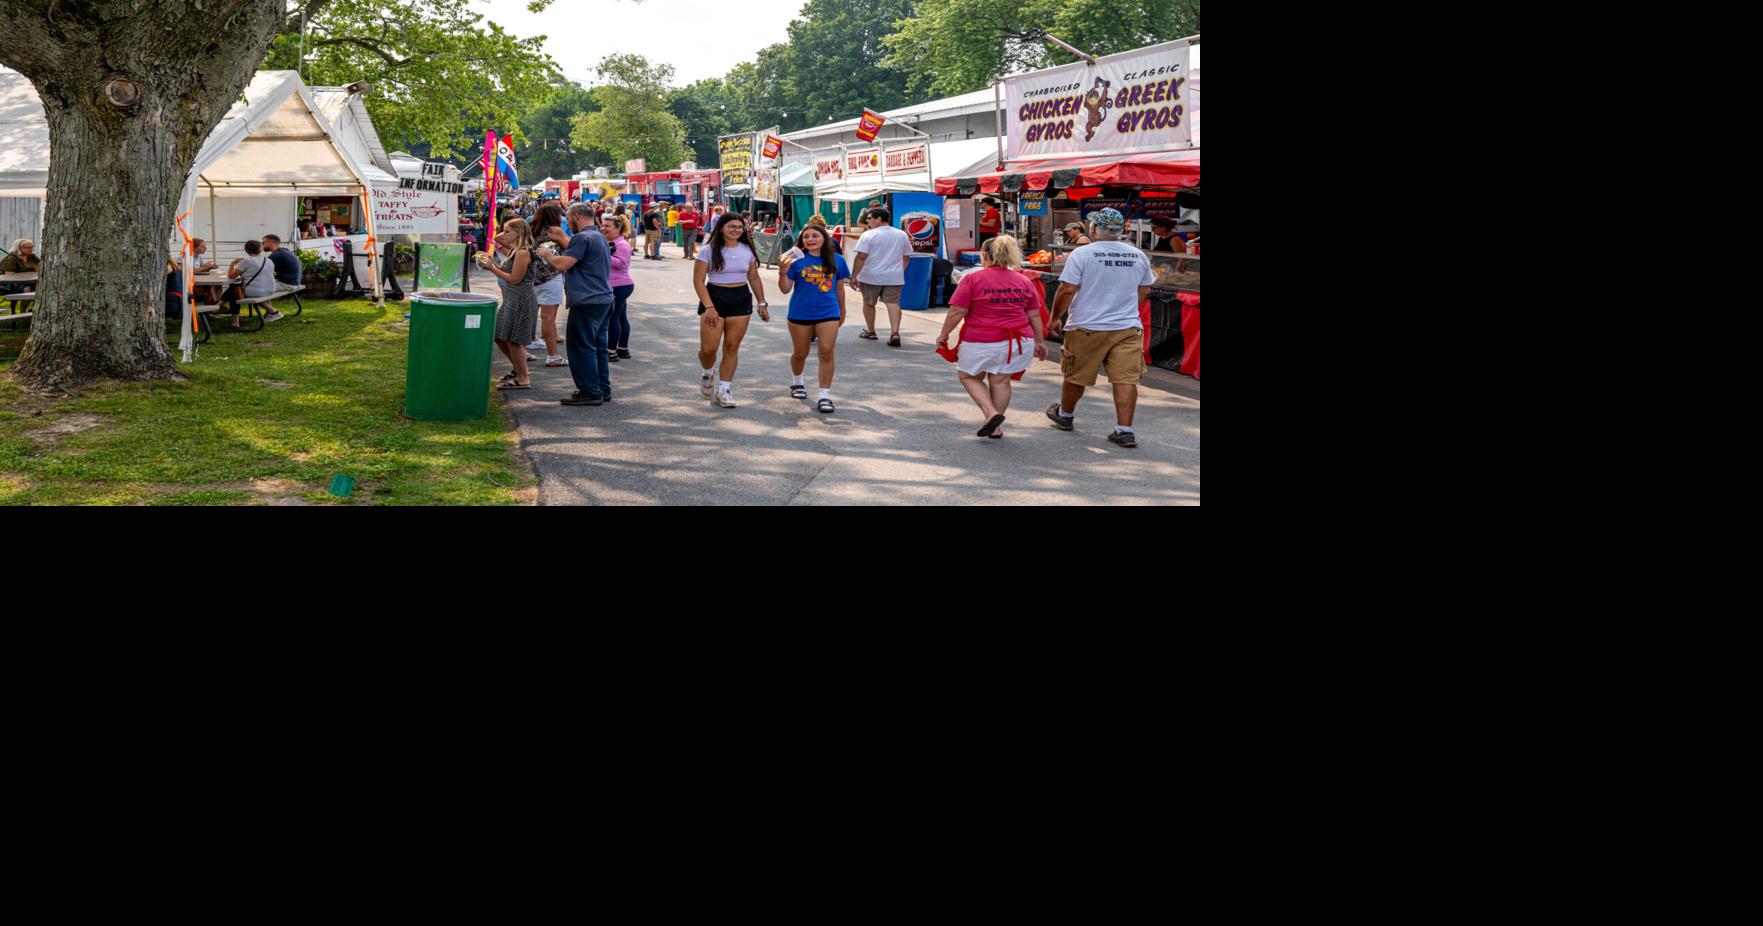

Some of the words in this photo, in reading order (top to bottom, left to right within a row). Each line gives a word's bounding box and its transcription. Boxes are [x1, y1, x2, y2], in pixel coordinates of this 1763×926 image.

[1123, 64, 1180, 81] CLASSIC
[1023, 82, 1081, 97] CHARBROILED
[1114, 77, 1185, 109] GREEK
[1019, 94, 1084, 122] CHICKEN
[1116, 104, 1184, 134] GYROS
[1025, 119, 1074, 143] GYROS
[422, 163, 445, 176] FAIR
[391, 188, 422, 199] Style
[400, 177, 464, 194] INFORMATION
[1024, 201, 1042, 210] FRIES
